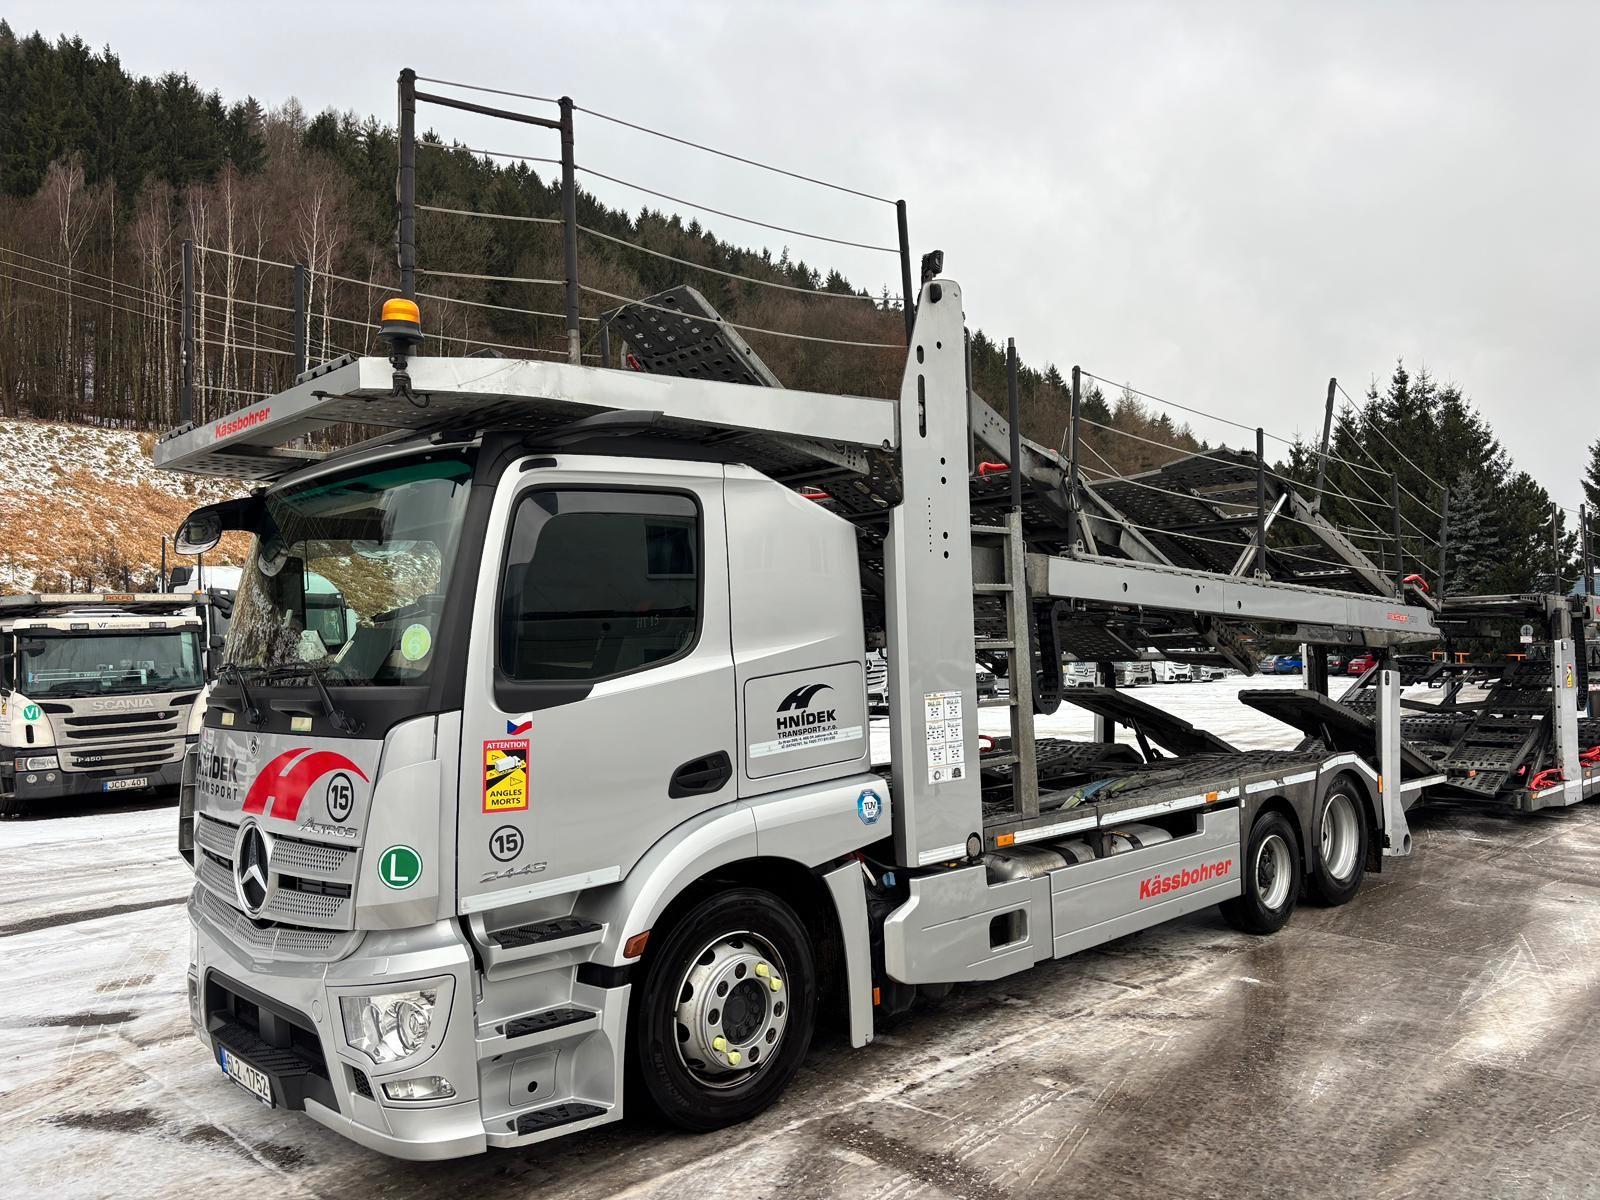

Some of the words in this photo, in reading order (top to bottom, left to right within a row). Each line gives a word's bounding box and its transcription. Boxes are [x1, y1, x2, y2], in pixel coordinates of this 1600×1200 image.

[215, 407, 270, 439] Kässbohrer
[92, 698, 155, 711] SCANIA
[776, 709, 837, 730] HNÍDEK
[777, 725, 822, 739] TRANSPORT
[486, 741, 528, 749] ATTENTION
[109, 780, 127, 789] JCD
[131, 778, 146, 787] 401
[490, 788, 522, 797] ANGLES
[331, 784, 350, 810] 15
[491, 797, 521, 806] MORTS
[494, 832, 519, 853] 15
[390, 853, 409, 881] L
[1139, 859, 1232, 900] Kässbohrer
[245, 1066, 269, 1098] 1752
